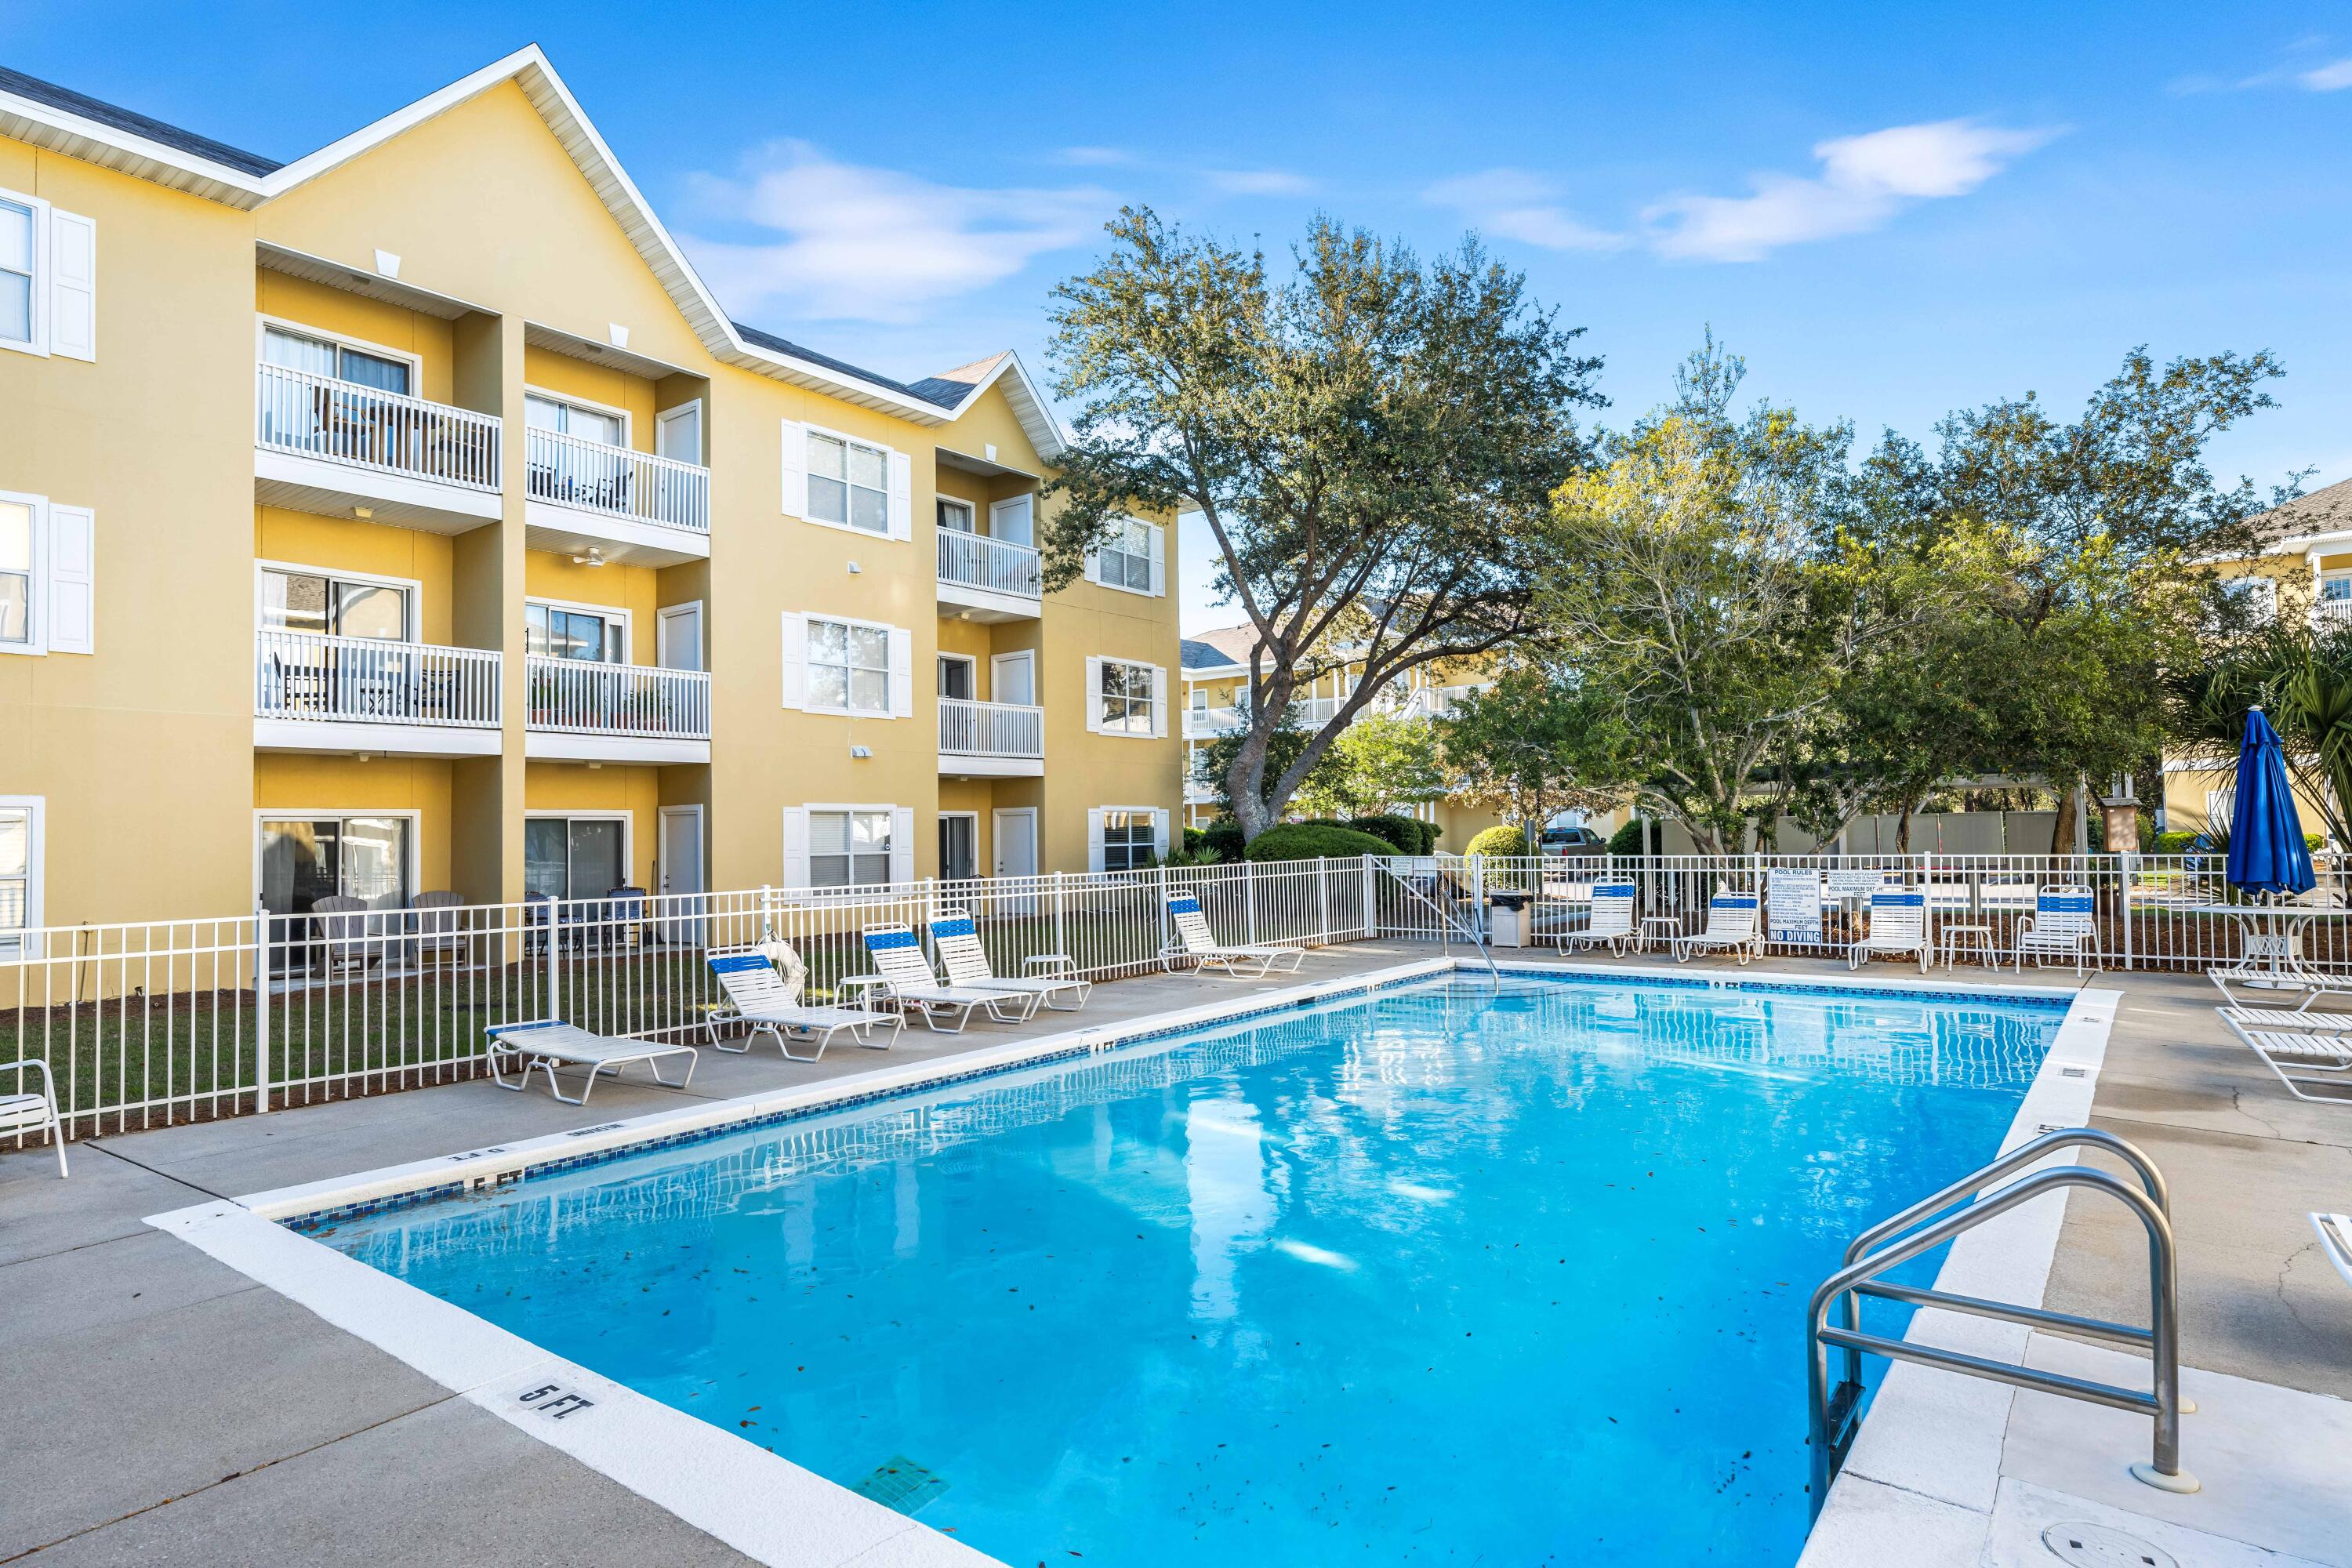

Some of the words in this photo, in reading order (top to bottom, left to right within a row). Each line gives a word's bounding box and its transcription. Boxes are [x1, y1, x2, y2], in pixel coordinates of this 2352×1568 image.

[1770, 931, 1784, 941] NO
[1787, 931, 1820, 942] DIVING
[519, 1384, 560, 1402] 5
